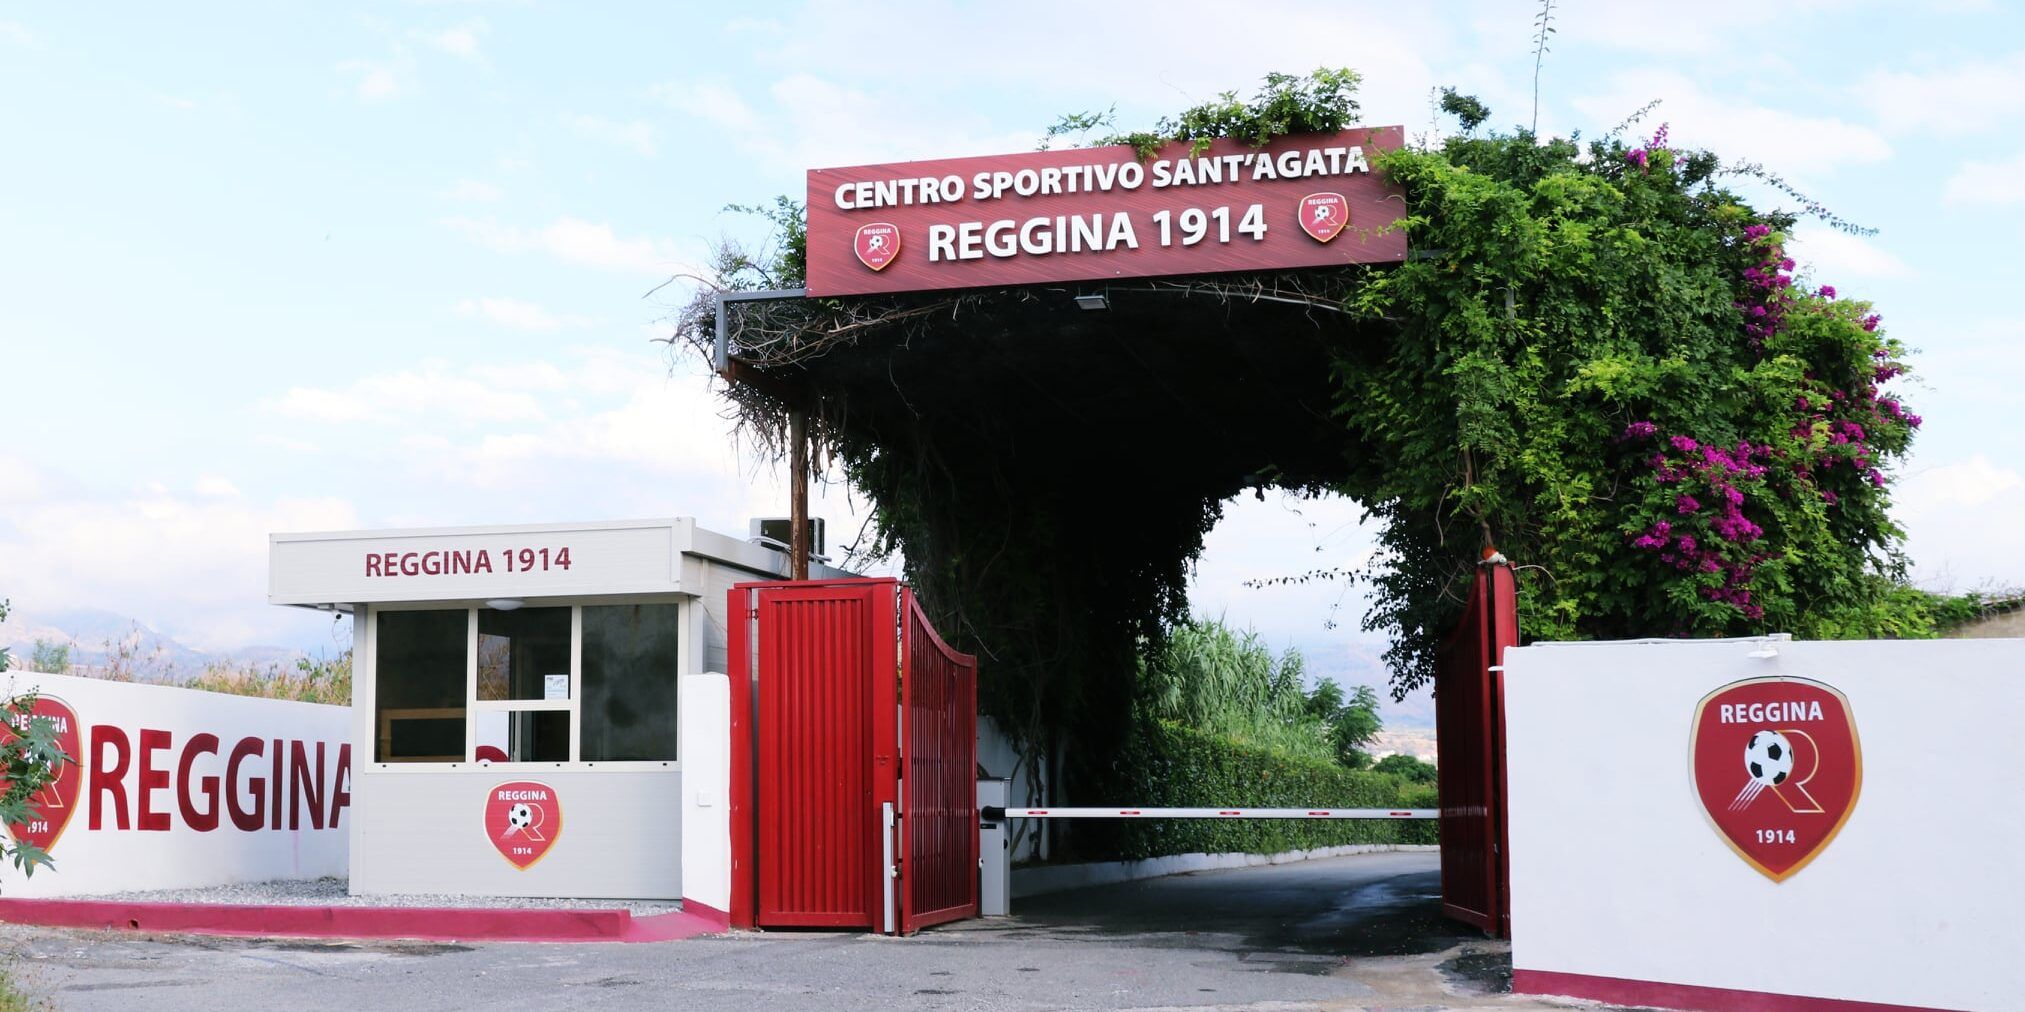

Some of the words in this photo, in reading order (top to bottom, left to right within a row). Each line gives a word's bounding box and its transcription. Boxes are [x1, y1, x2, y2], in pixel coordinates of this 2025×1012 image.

[834, 174, 965, 211] CENTRO
[973, 161, 1144, 201] SPORTIVO
[1152, 145, 1370, 188] SANT'AGATA
[929, 211, 1139, 262] REGGINA
[1152, 203, 1268, 247] 1914
[365, 549, 493, 577] REGGINA
[502, 547, 572, 573] 1914
[1720, 700, 1824, 724] REGGINA
[88, 724, 351, 833] REGGINA
[498, 790, 547, 801] REGGINA
[1756, 829, 1796, 844] 1914
[513, 847, 532, 855] 1914
